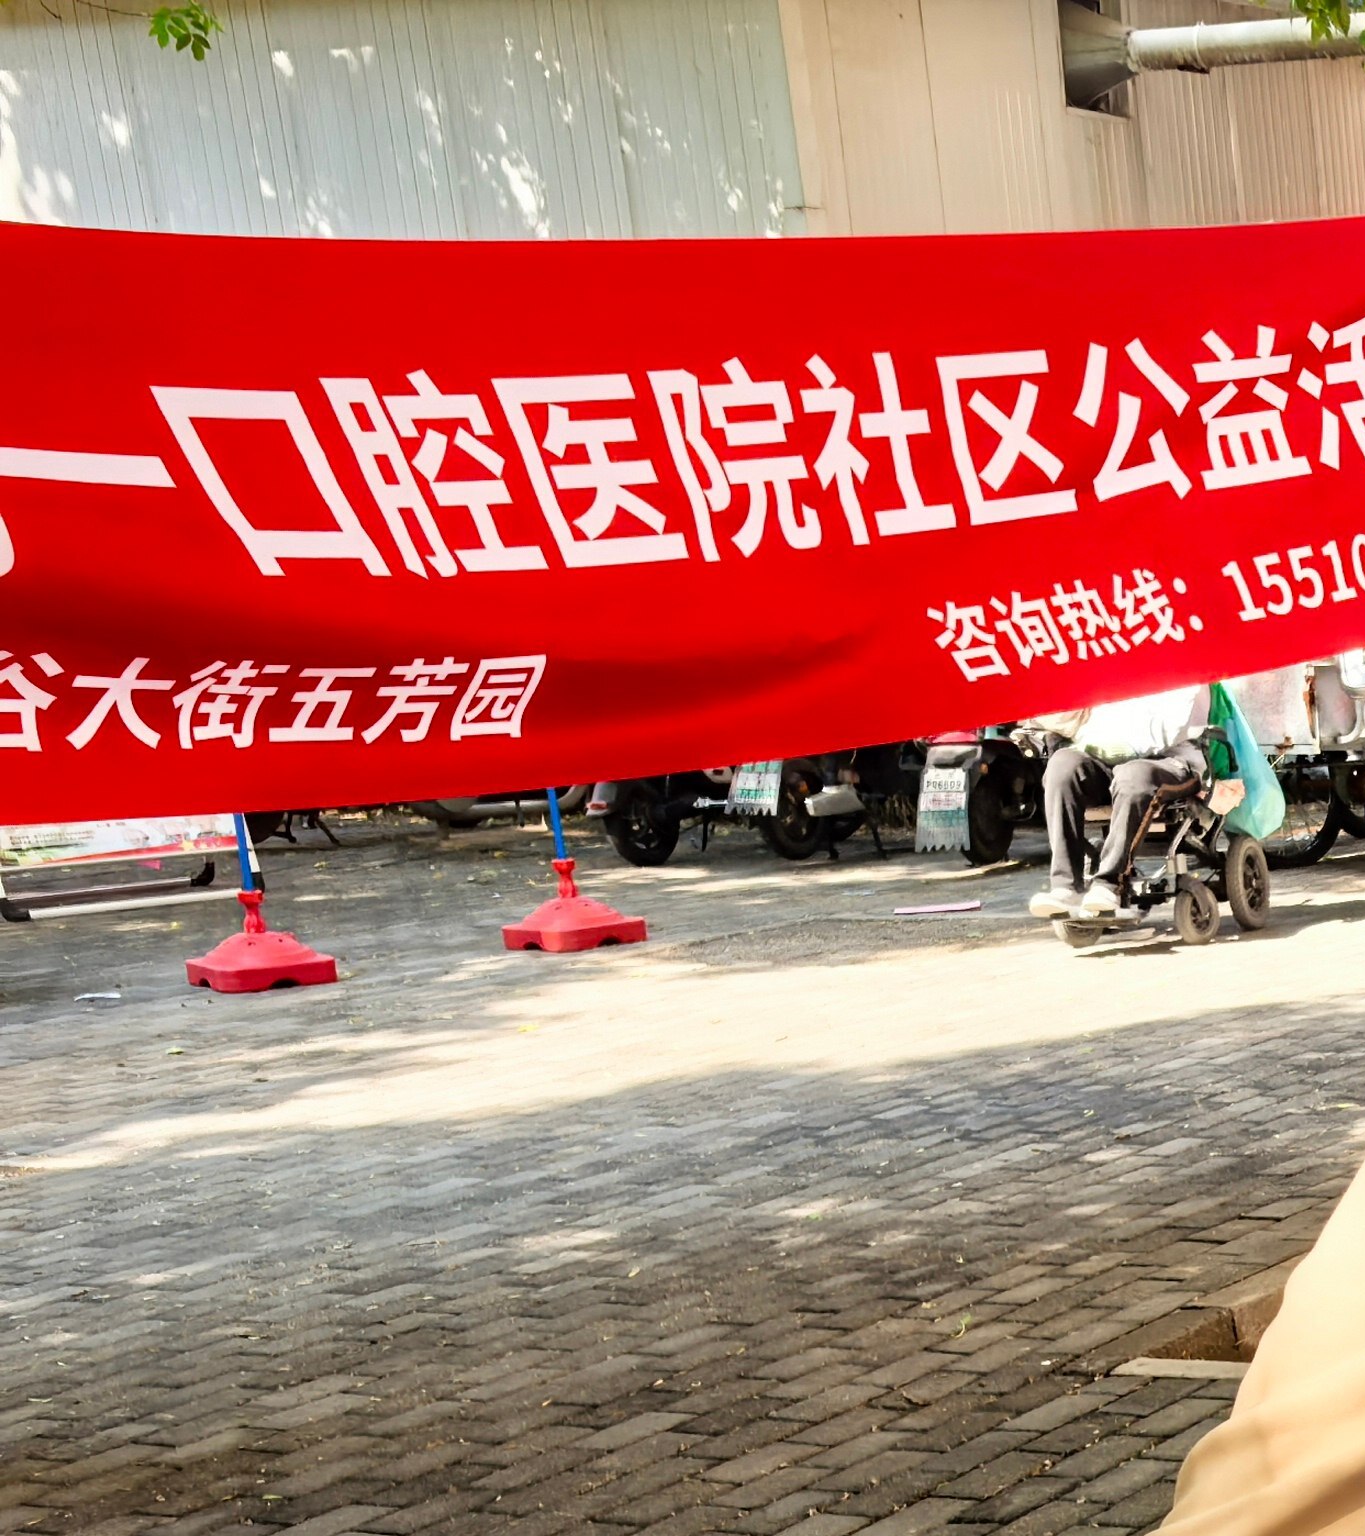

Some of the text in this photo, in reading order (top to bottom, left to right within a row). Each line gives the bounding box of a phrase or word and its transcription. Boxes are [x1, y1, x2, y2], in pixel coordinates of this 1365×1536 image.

[0, 649, 547, 753] 谷大街五芳园
